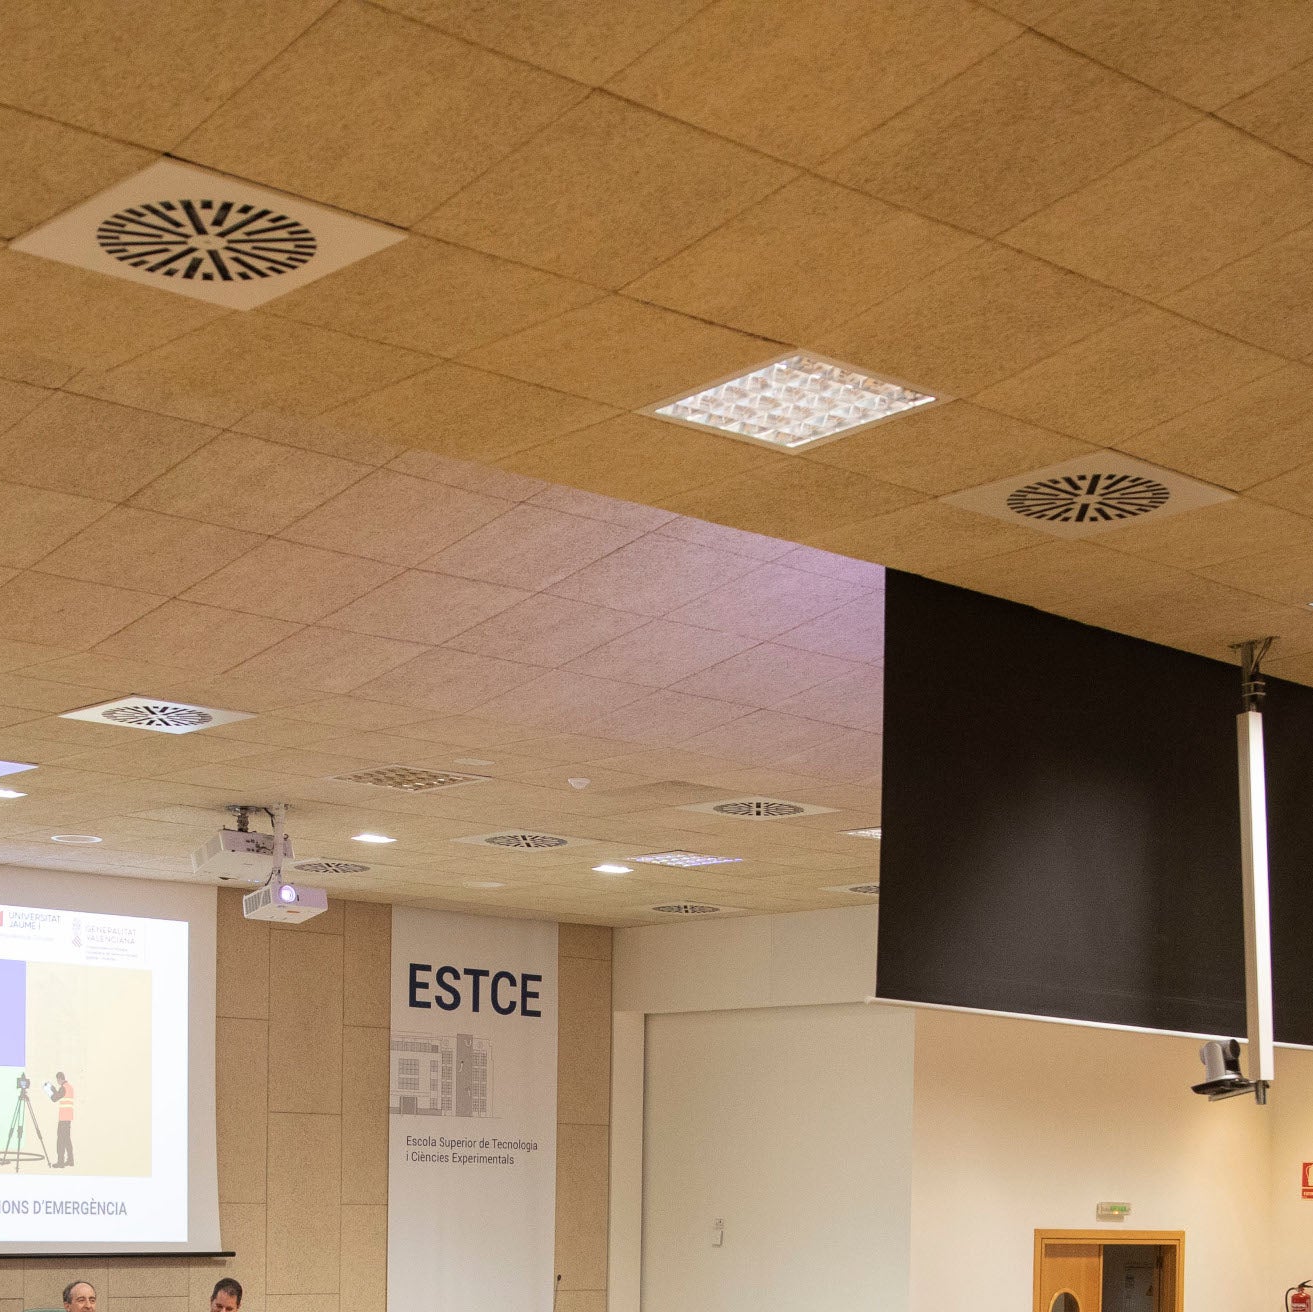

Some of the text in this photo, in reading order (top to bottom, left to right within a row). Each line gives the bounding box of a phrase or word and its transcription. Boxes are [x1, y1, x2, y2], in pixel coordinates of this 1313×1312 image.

[8, 911, 61, 925] UNIVERSITAT
[9, 920, 36, 930] JAUME
[408, 962, 543, 1018] ESTCE
[406, 1135, 538, 1153] Escola Superior de Tecnologia
[411, 1150, 449, 1163] Ciències
[452, 1152, 515, 1166] Experimentals
